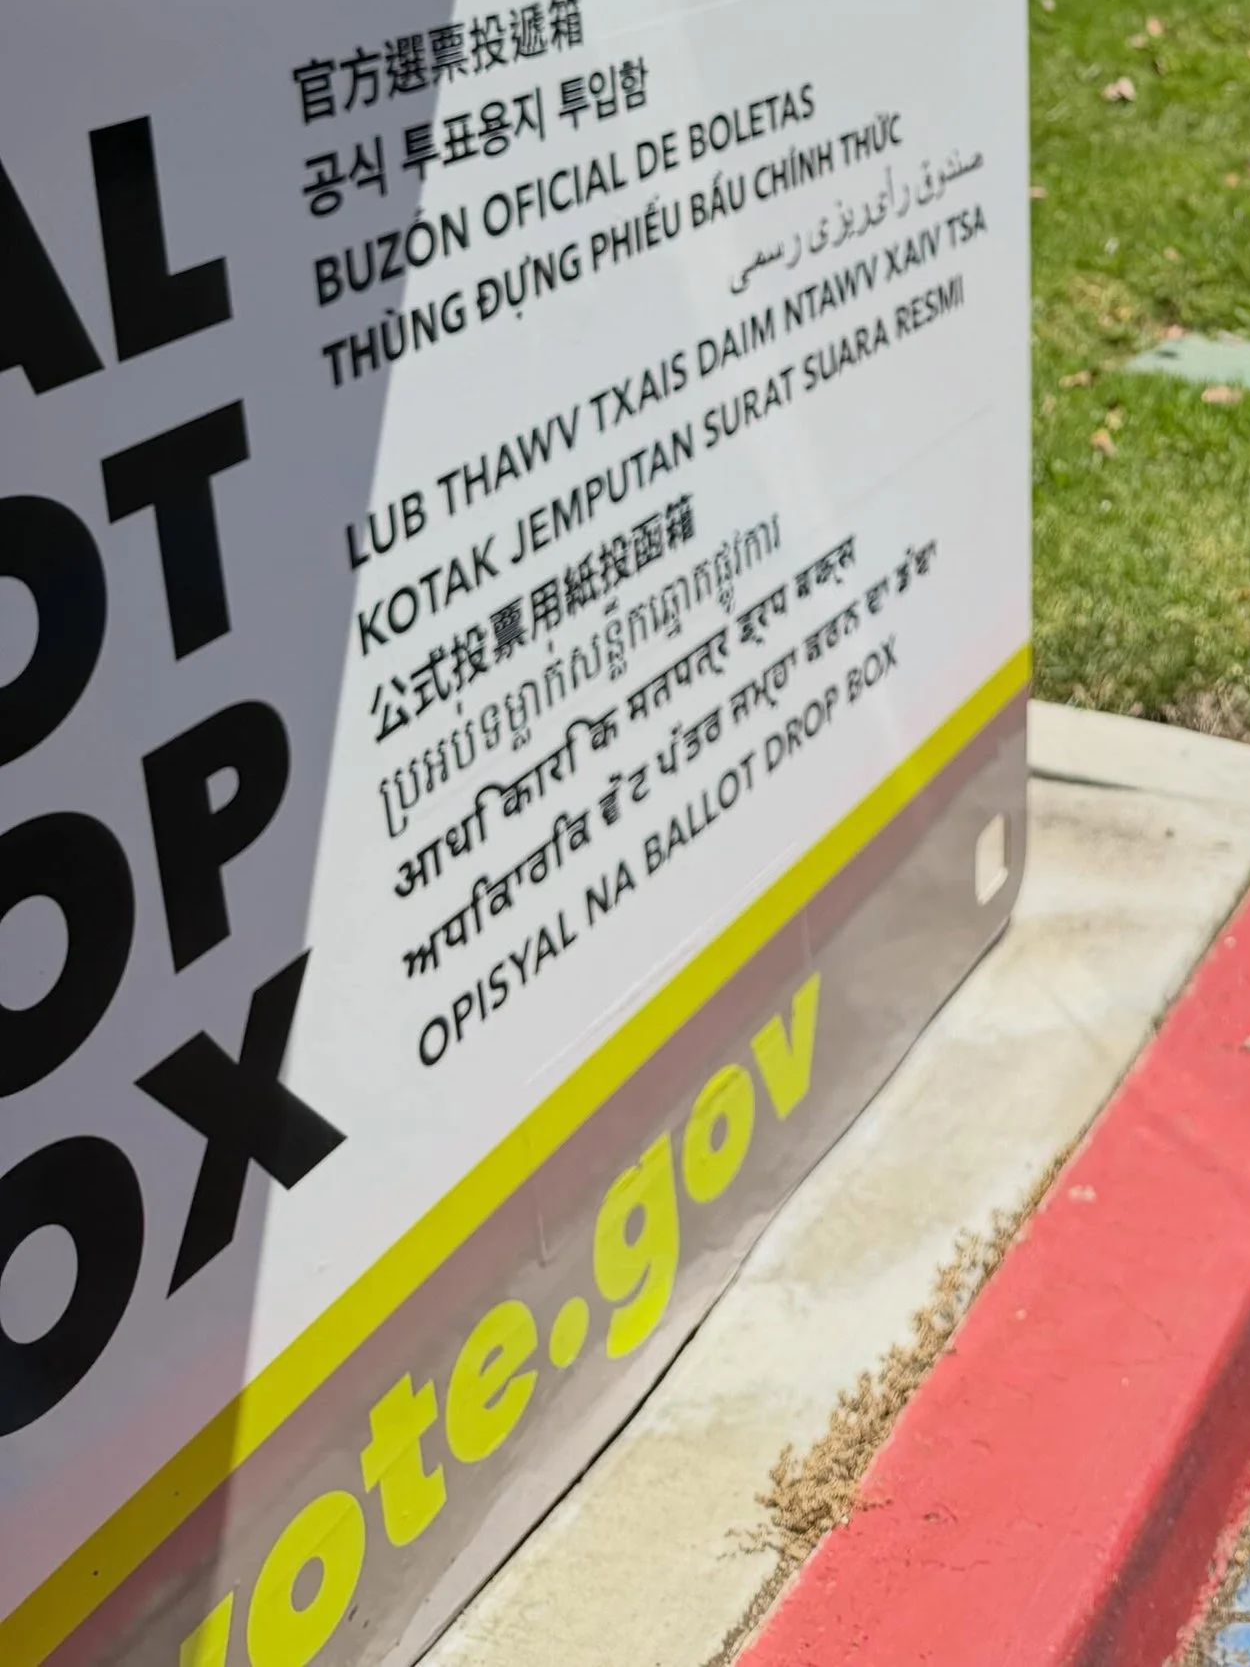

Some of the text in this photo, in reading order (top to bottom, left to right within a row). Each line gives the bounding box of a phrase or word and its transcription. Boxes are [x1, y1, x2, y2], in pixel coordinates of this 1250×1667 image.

[300, 54, 649, 219] 공식 투표용지 투입함
[312, 81, 816, 308] BUZÓN OFICIAL DE BOLETAS
[320, 288, 468, 389] THÙNG
[751, 139, 835, 202] CHÍNH
[344, 204, 987, 571] LUB THAWV TXAIS DAIM NTAWV XAIV TSA
[355, 274, 964, 658] KOTAK JEMPUTAN SURAT SUARA RESMI
[368, 492, 696, 745] 公式投票用紙投函箱
[417, 634, 898, 1069] OPISYAL NA BALLOT DROP BOX
